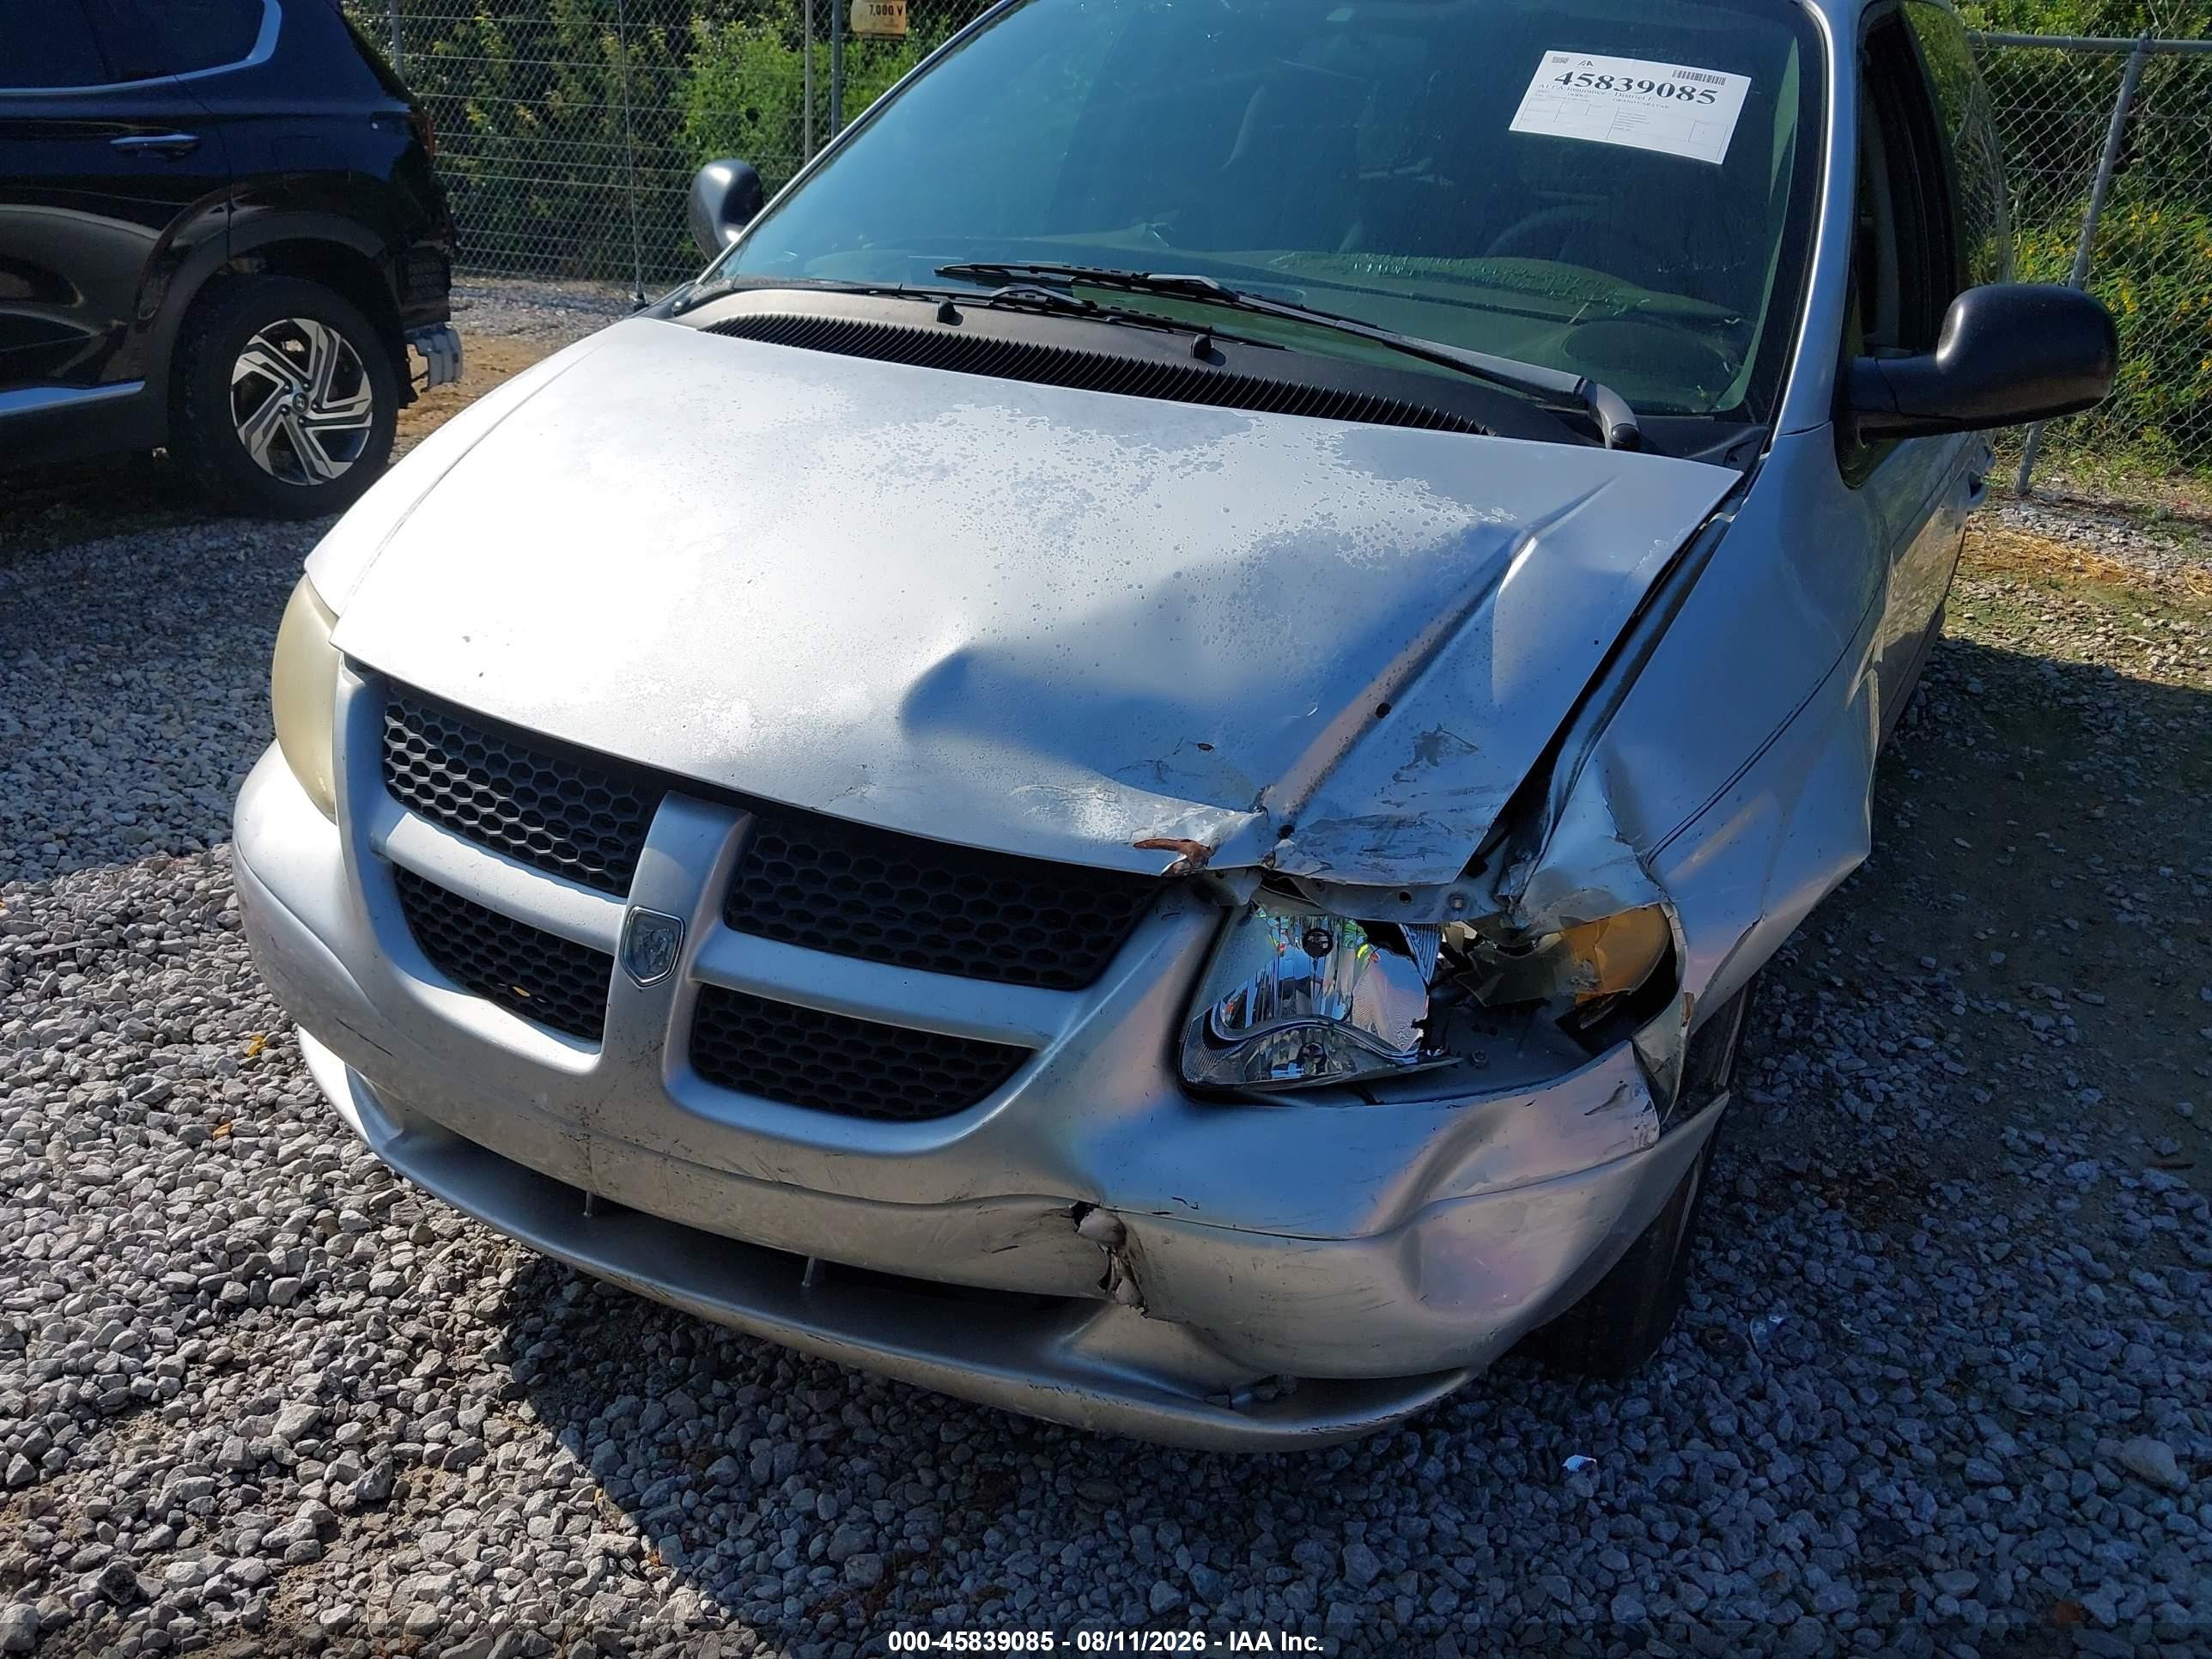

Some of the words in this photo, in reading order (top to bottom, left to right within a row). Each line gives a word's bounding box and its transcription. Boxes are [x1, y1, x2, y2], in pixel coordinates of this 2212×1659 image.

[869, 4, 894, 16] 7,000
[896, 5, 903, 16] V
[1554, 70, 1718, 105] 45839085
